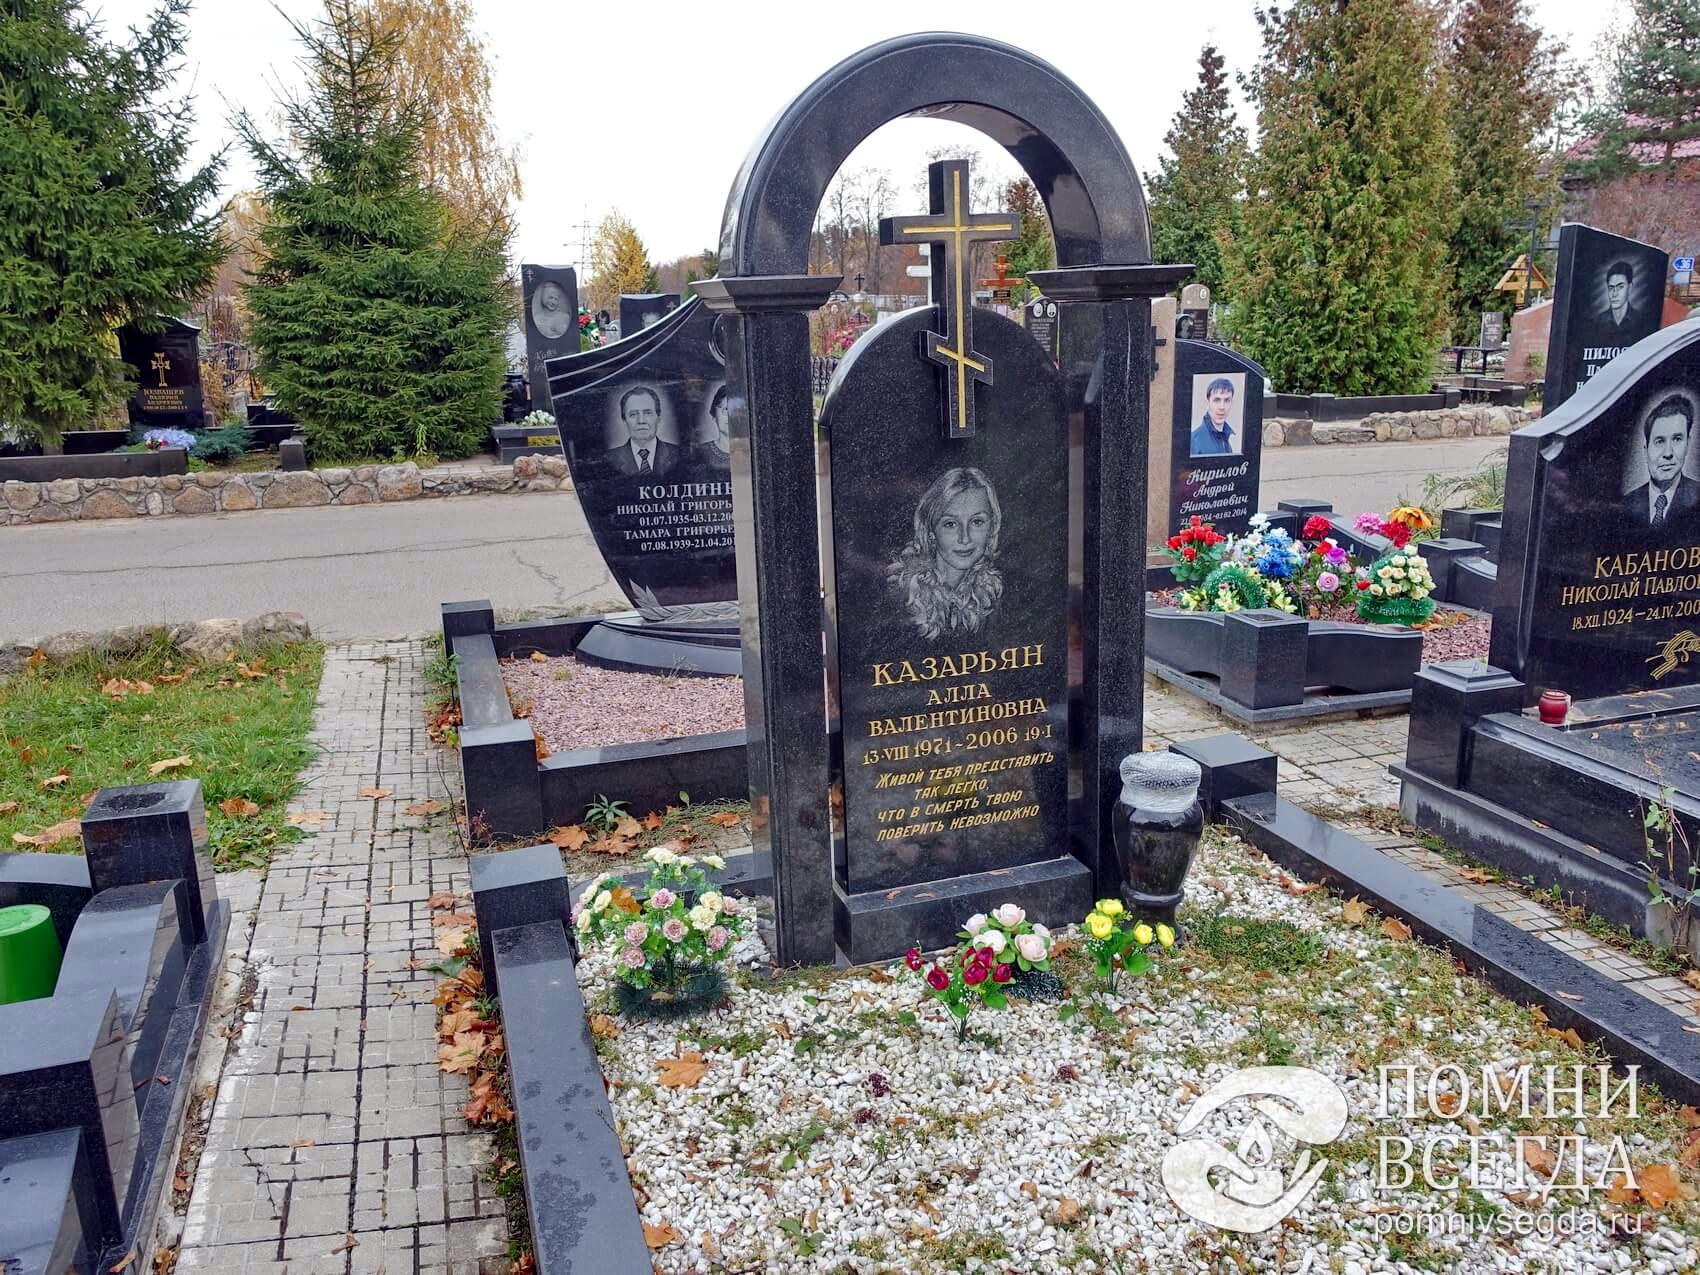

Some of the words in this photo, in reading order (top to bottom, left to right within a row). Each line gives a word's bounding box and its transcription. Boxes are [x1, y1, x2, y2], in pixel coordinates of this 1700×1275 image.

[1680, 259, 1691, 269] 36
[1186, 461, 1249, 486] Кирилов
[1193, 482, 1234, 498] Андрей
[617, 501, 675, 515] НИКОЛАЙ
[1180, 494, 1248, 514] Николаевич
[640, 512, 733, 526] 01.07.1935-03.12.20
[624, 528, 671, 540] ТАМАРА
[1594, 547, 1700, 579] КАБАНОВ
[1561, 577, 1640, 606] НИКОЛАЙ
[872, 644, 1044, 687] КАЗАРЬЯН
[926, 683, 992, 706] АЛЛА
[868, 697, 1048, 737] ВАЛЕНТИНОВНА
[876, 768, 924, 789] ЖИВОЙ
[929, 765, 961, 781] ТЕБЯ
[965, 752, 1054, 775] ПРЕДСТАВИТЬ
[914, 786, 943, 800] ТАК
[944, 779, 990, 796] ЛЕГКО,
[878, 808, 905, 823] ЧТО
[911, 806, 920, 818] В
[925, 797, 979, 816] СМЕРТЬ
[987, 790, 1023, 806] ТВОЮ
[877, 820, 944, 842] ПОВЕРИТЬ
[950, 805, 1040, 830] НЕВОЗМОЖНО
